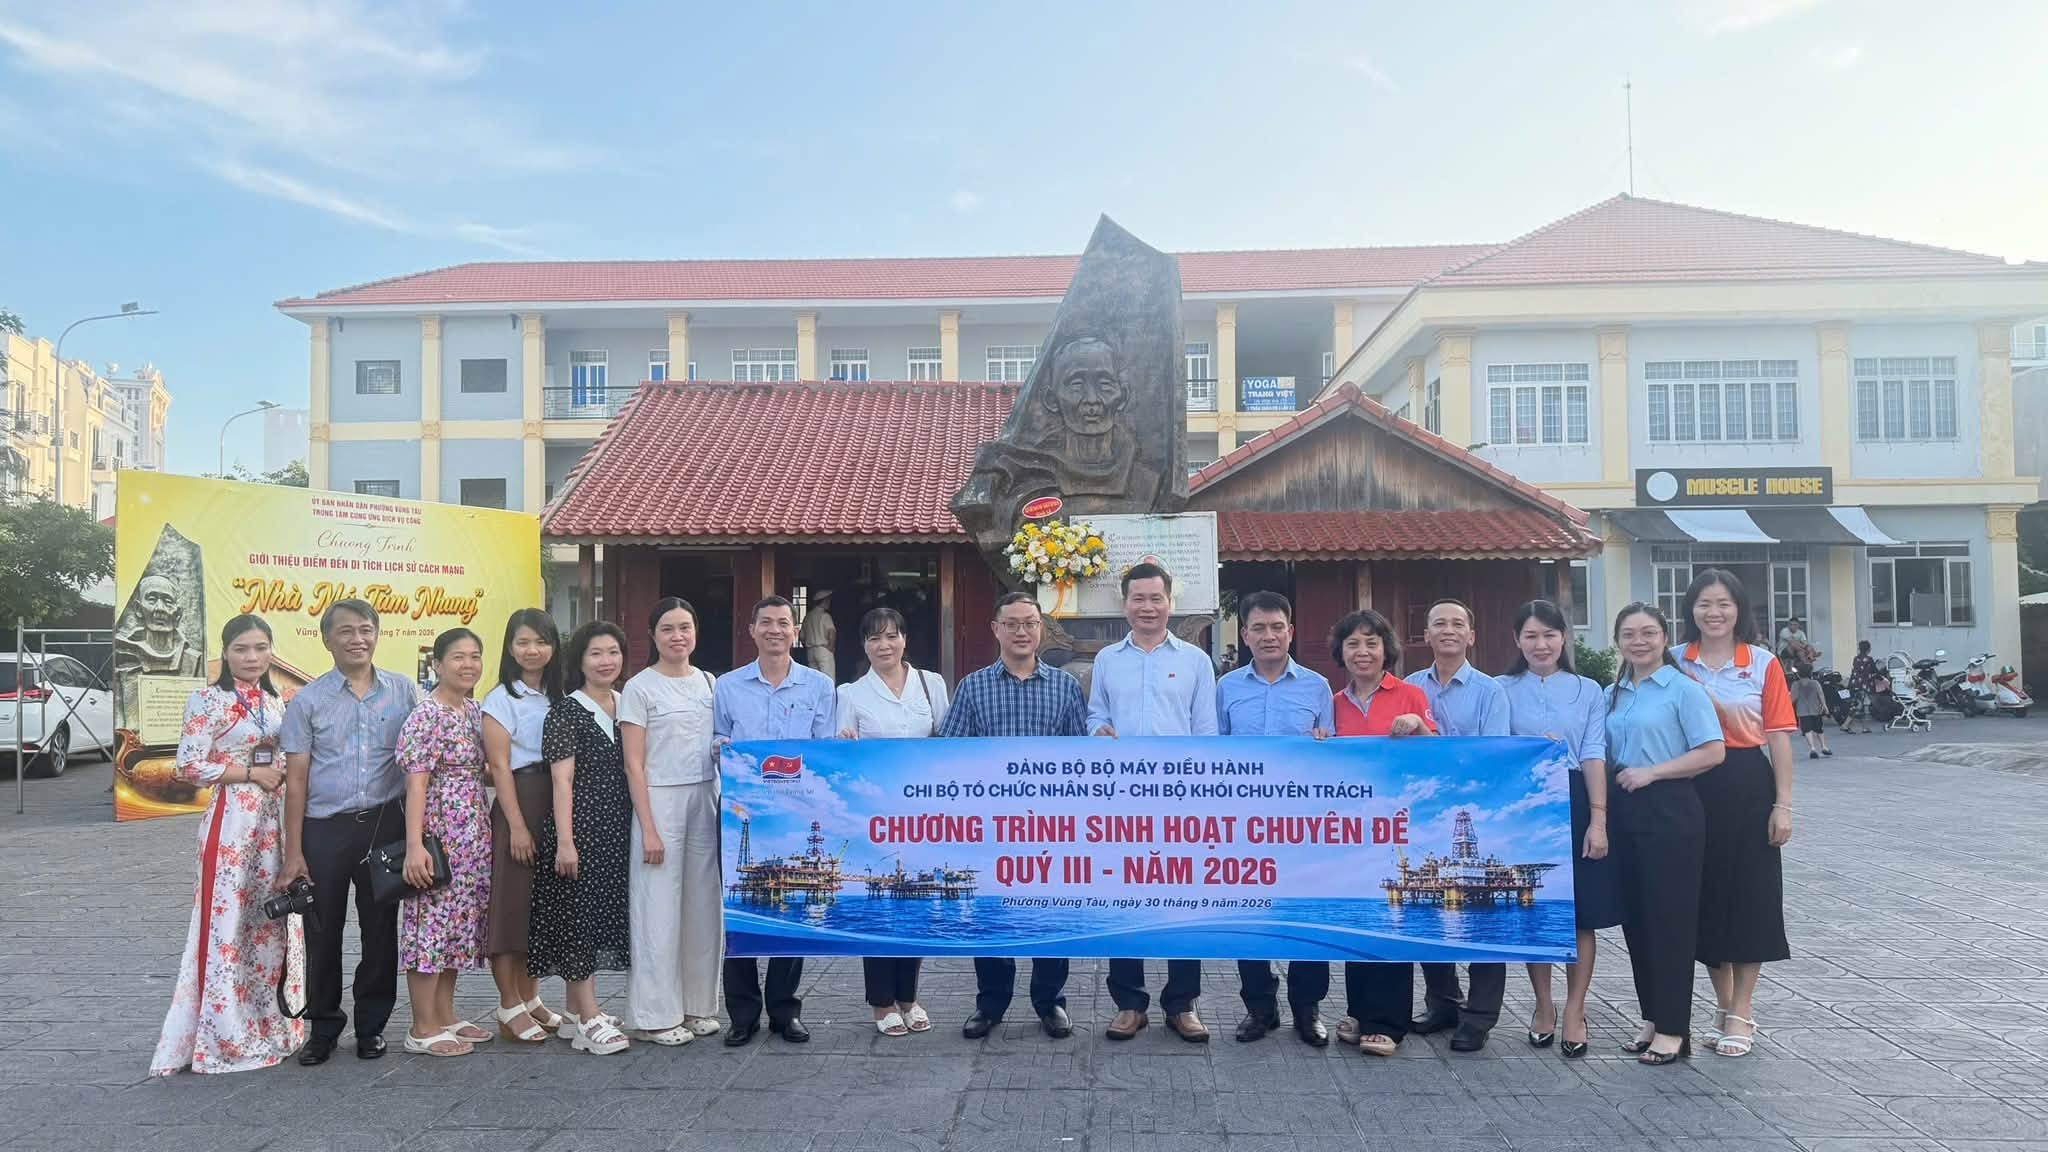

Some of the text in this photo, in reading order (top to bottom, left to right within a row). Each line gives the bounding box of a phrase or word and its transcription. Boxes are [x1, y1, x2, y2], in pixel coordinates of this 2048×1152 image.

[1247, 380, 1277, 389] YOGA
[1686, 477, 1823, 496] MUSCLE HOUSE
[351, 560, 360, 570] DI
[1006, 757, 1264, 777] ĐẢNG BỘ BỘ MÁY ĐIỀU HÀNH
[903, 784, 932, 798] CHI
[935, 781, 960, 801] BỘ
[988, 781, 1037, 798] CHỨC
[1040, 780, 1089, 798] NHÂN
[1092, 783, 1117, 800] SỰ
[1129, 784, 1159, 797] CHI
[1163, 780, 1187, 800] BỘ
[1190, 780, 1232, 798] KHỐI
[1236, 781, 1309, 798] CHUYÊN
[1313, 781, 1373, 798] TRÁCH
[868, 808, 1409, 850] CHƯƠNG TRÌNH SINH HOẠT CHUYÊN ĐỀ
[995, 850, 1053, 887] QUÝ
[1063, 856, 1092, 884] III
[1123, 850, 1193, 884] NĂM
[1203, 857, 1278, 885] 2026
[1001, 896, 1272, 910] Phường Vũng Tàu, ngày 30 tháng 9 năm 2026
